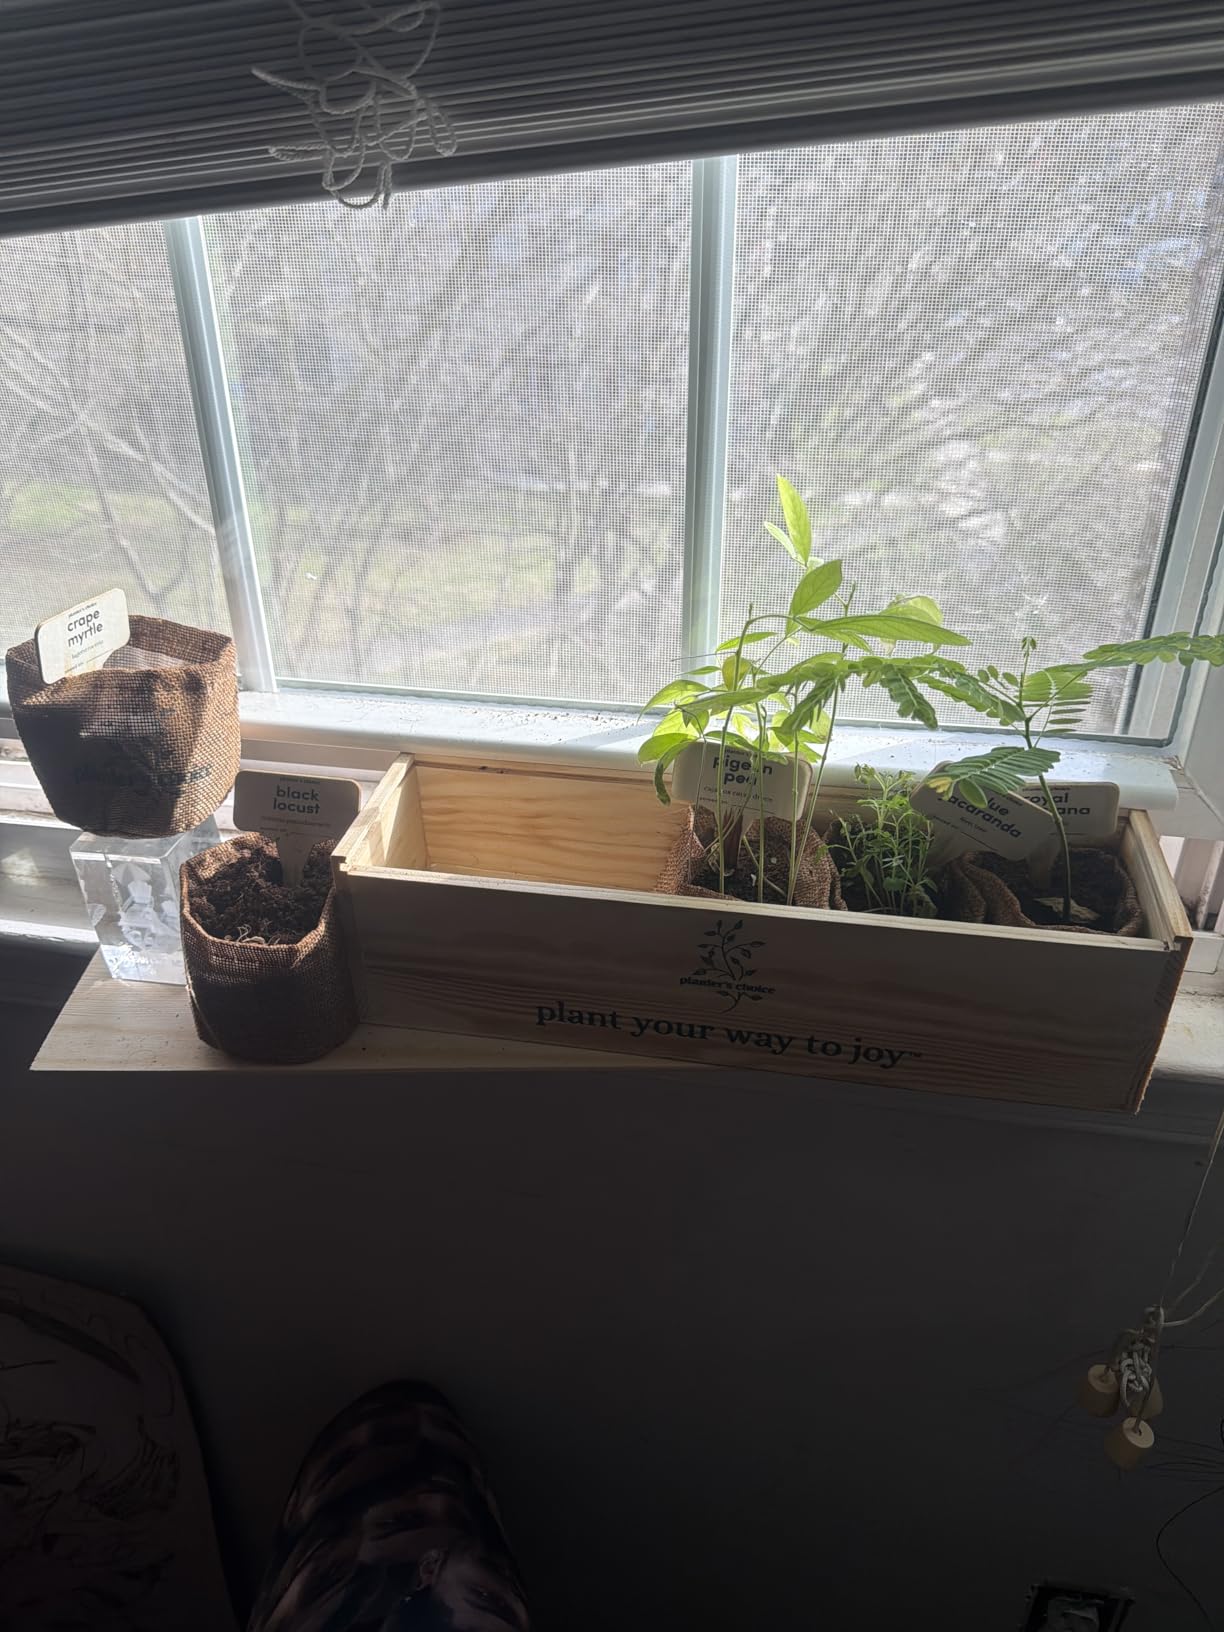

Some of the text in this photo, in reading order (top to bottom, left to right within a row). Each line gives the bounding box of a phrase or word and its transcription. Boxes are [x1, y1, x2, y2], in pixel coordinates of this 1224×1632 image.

[67, 610, 100, 632] crape
[67, 622, 104, 647] myrtle
[712, 755, 773, 776] pigen
[276, 784, 320, 801] black
[272, 797, 320, 814] locust
[937, 796, 1022, 838] acaranda
[736, 984, 776, 994] choice
[535, 1001, 622, 1030] plant
[630, 1016, 715, 1041] your
[723, 1027, 794, 1055] way
[806, 1036, 842, 1057] to
